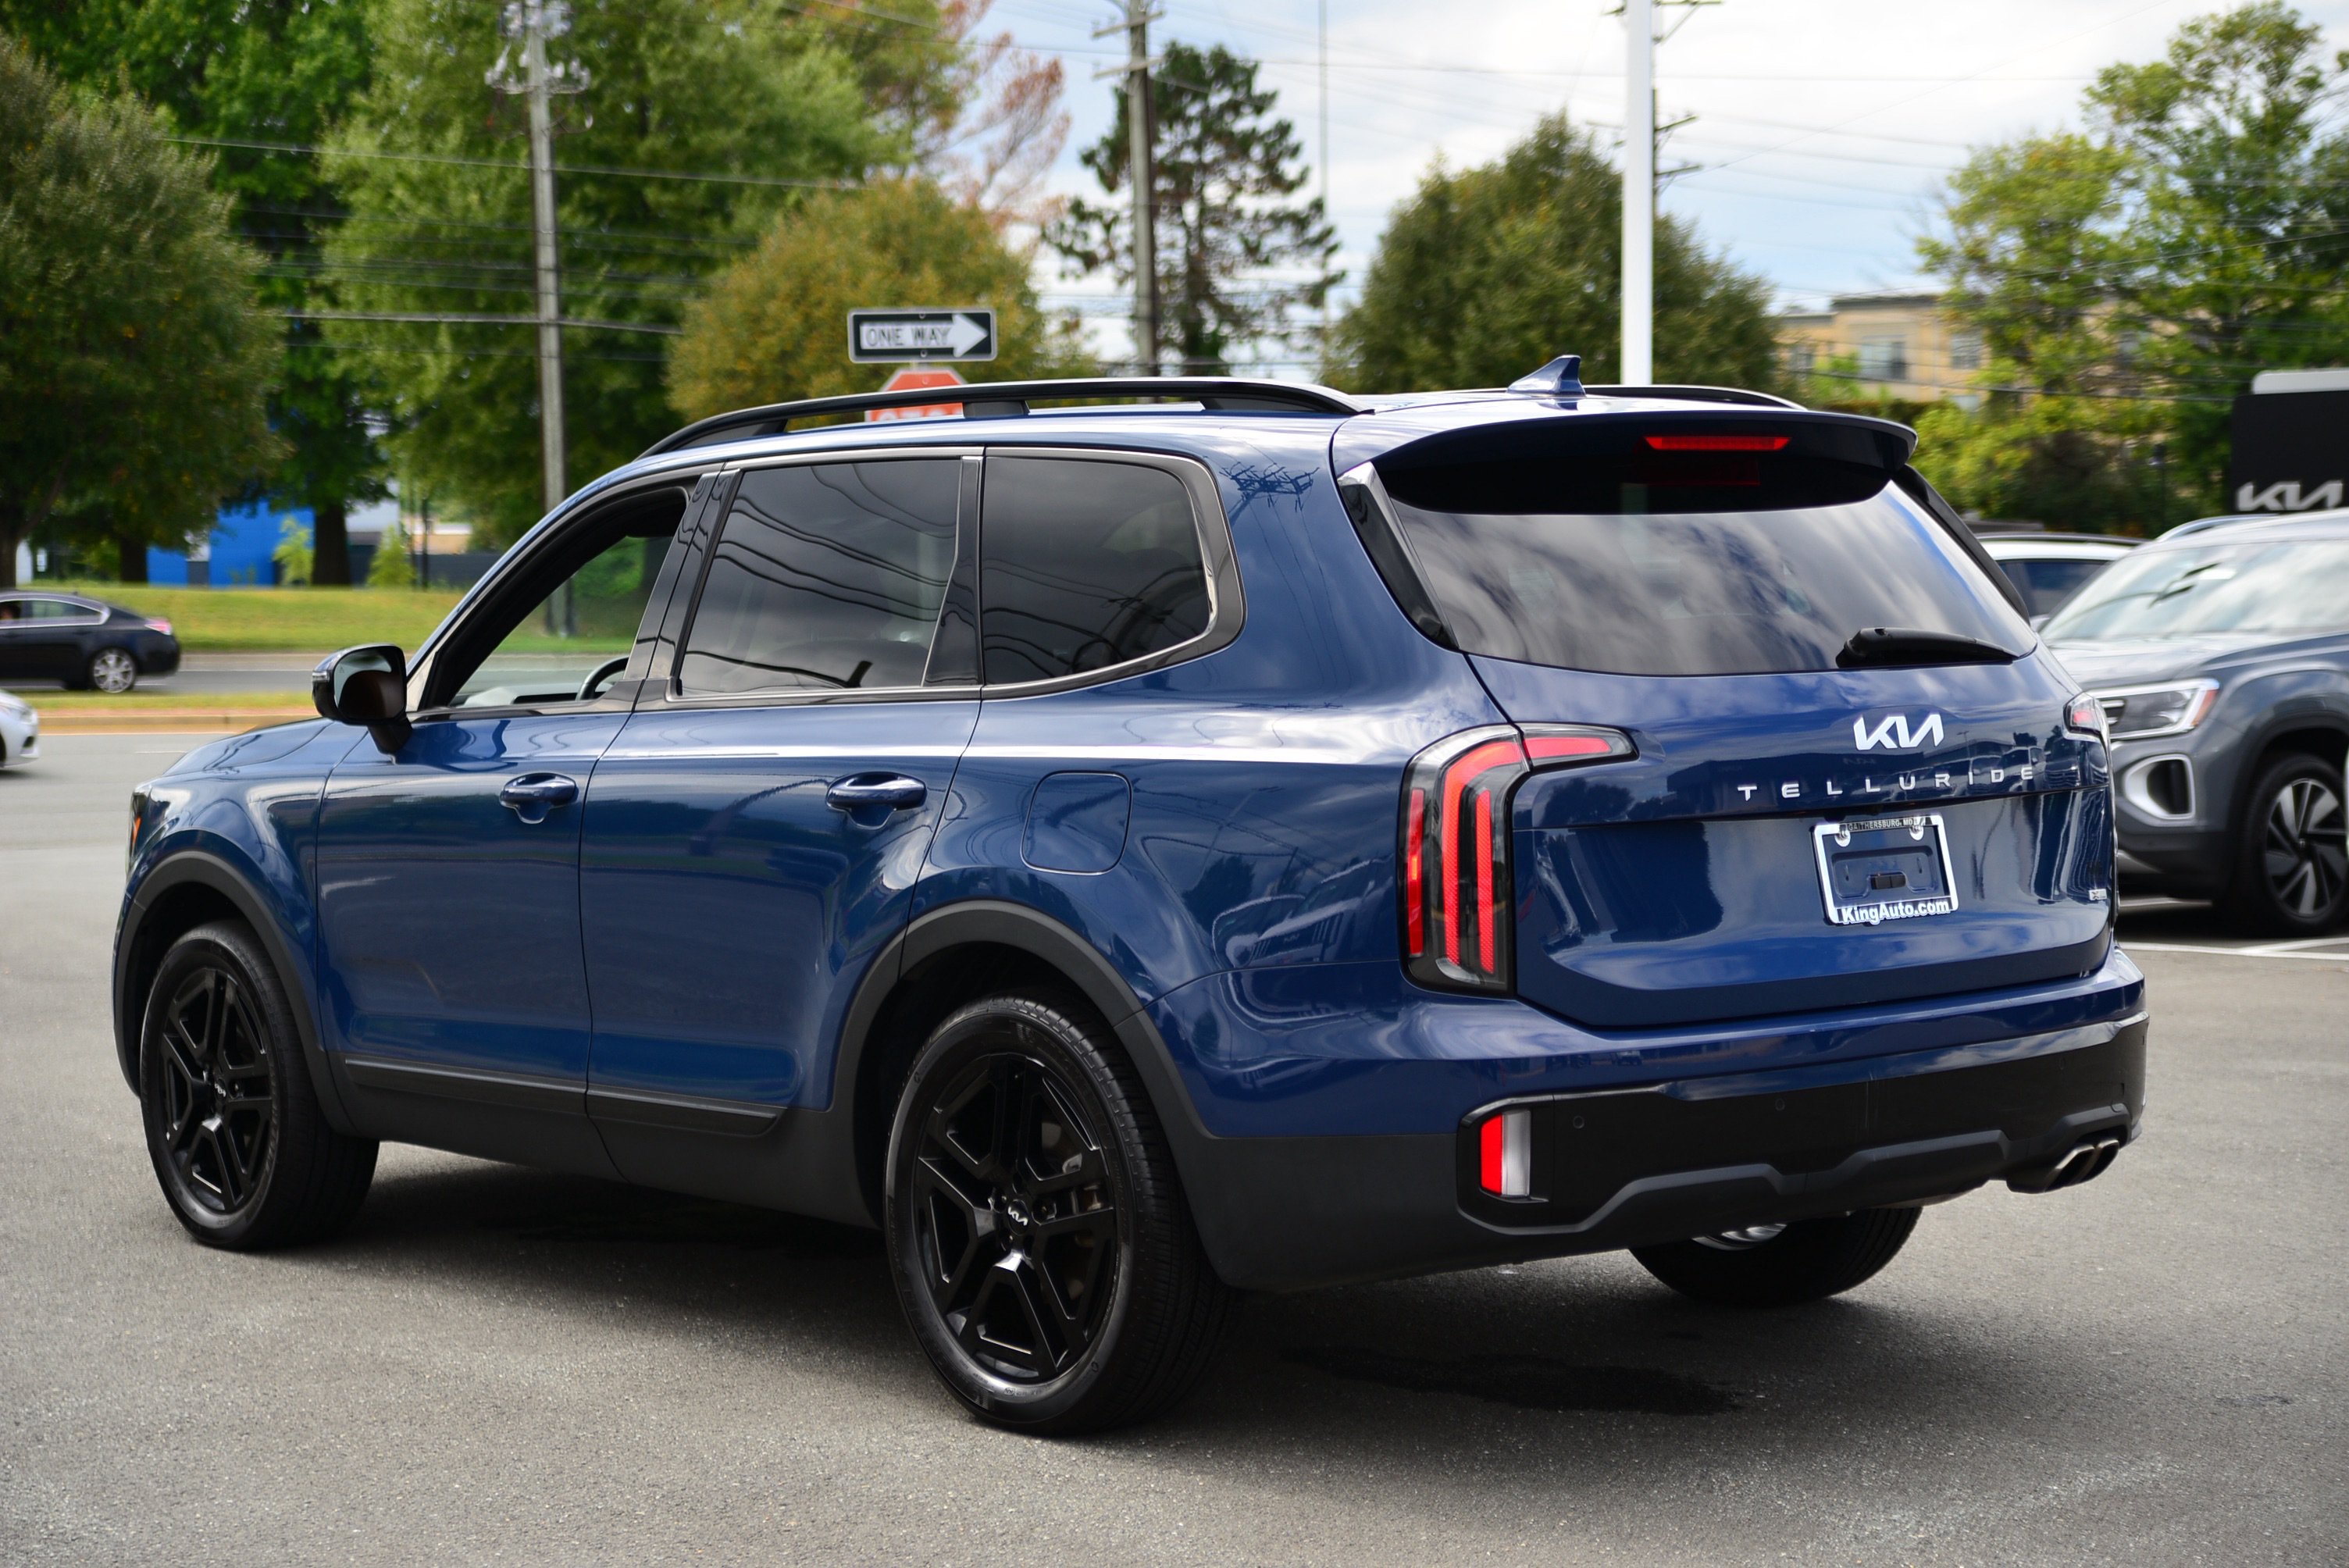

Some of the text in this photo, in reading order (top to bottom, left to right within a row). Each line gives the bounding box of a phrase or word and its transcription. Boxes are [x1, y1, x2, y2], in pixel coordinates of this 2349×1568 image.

[865, 326, 953, 347] ONE WAY
[2237, 480, 2343, 511] KIA
[1853, 714, 1944, 750] KIA
[1738, 767, 2034, 801] TELLURIDE
[1841, 900, 1951, 925] KingAuto.com
